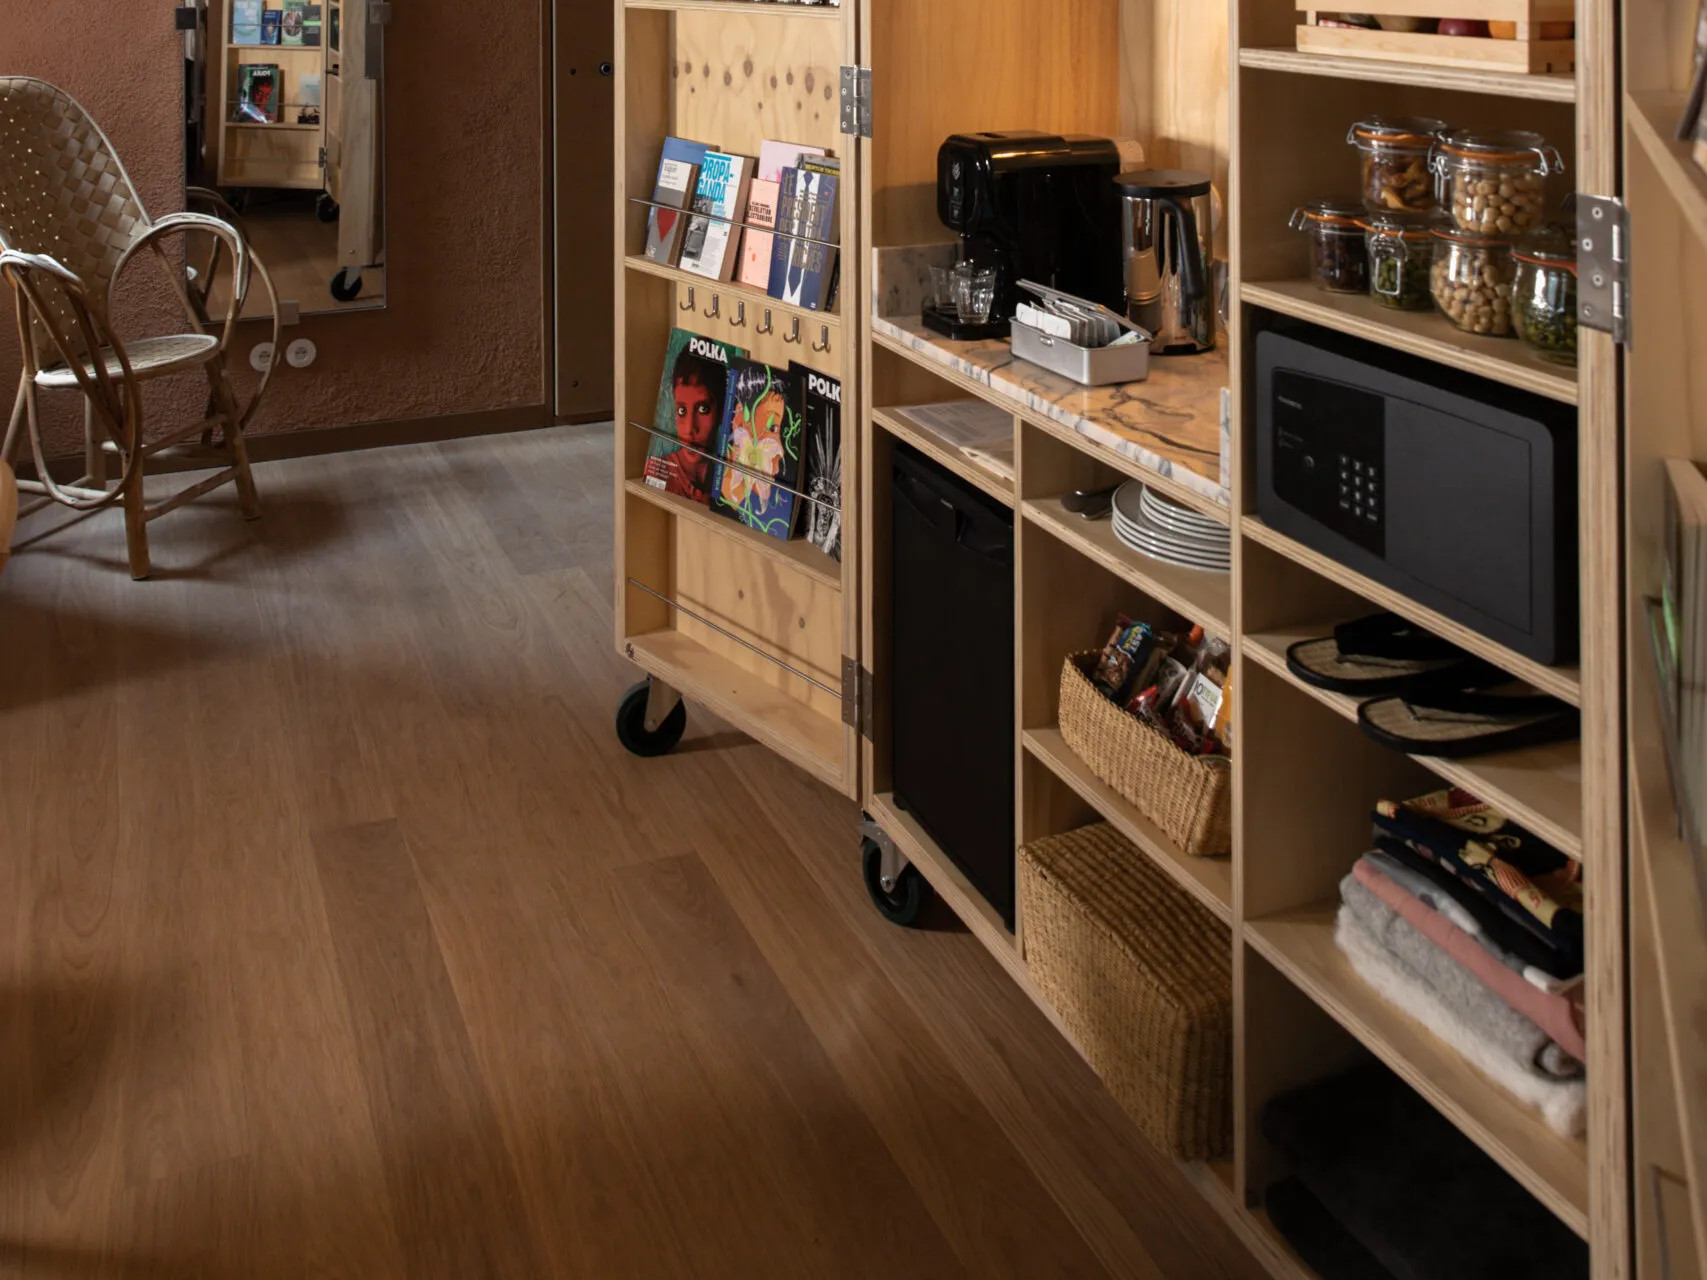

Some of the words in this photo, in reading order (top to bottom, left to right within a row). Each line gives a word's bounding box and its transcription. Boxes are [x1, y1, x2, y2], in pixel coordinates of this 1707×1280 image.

[702, 158, 734, 183] PROPA-
[696, 178, 727, 204] GANDA
[689, 337, 729, 364] POLKA
[808, 373, 841, 403] POLK
